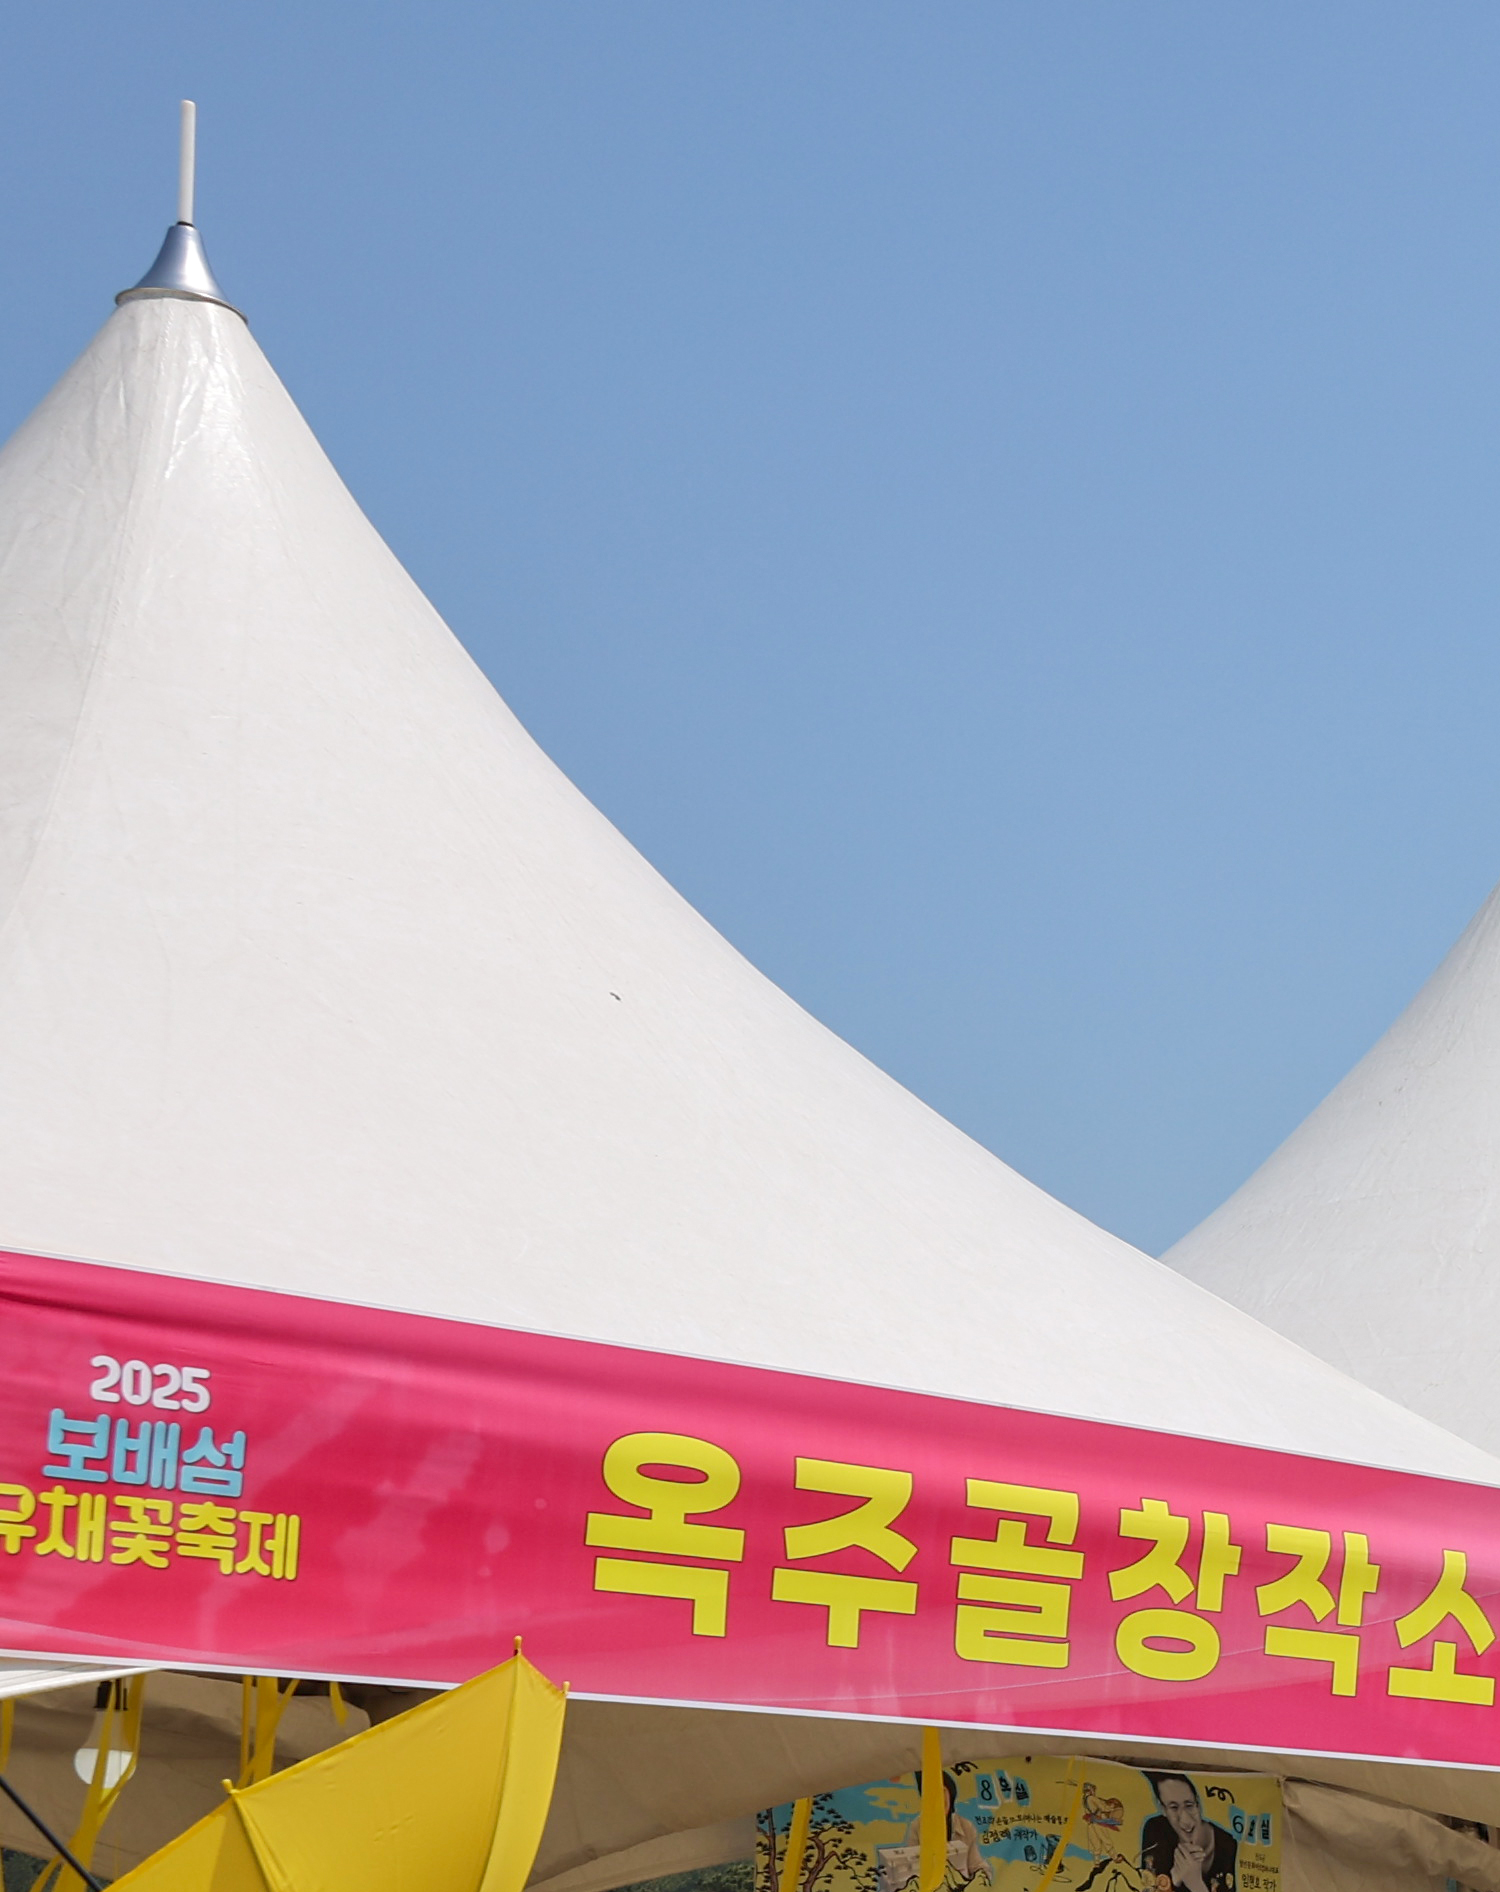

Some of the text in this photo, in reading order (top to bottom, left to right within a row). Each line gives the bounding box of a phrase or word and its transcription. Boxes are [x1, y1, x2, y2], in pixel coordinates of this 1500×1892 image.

[89, 1354, 211, 1413] 2025
[42, 1407, 247, 1498] 보배섬
[0, 1484, 302, 1582] 유채꽃축제
